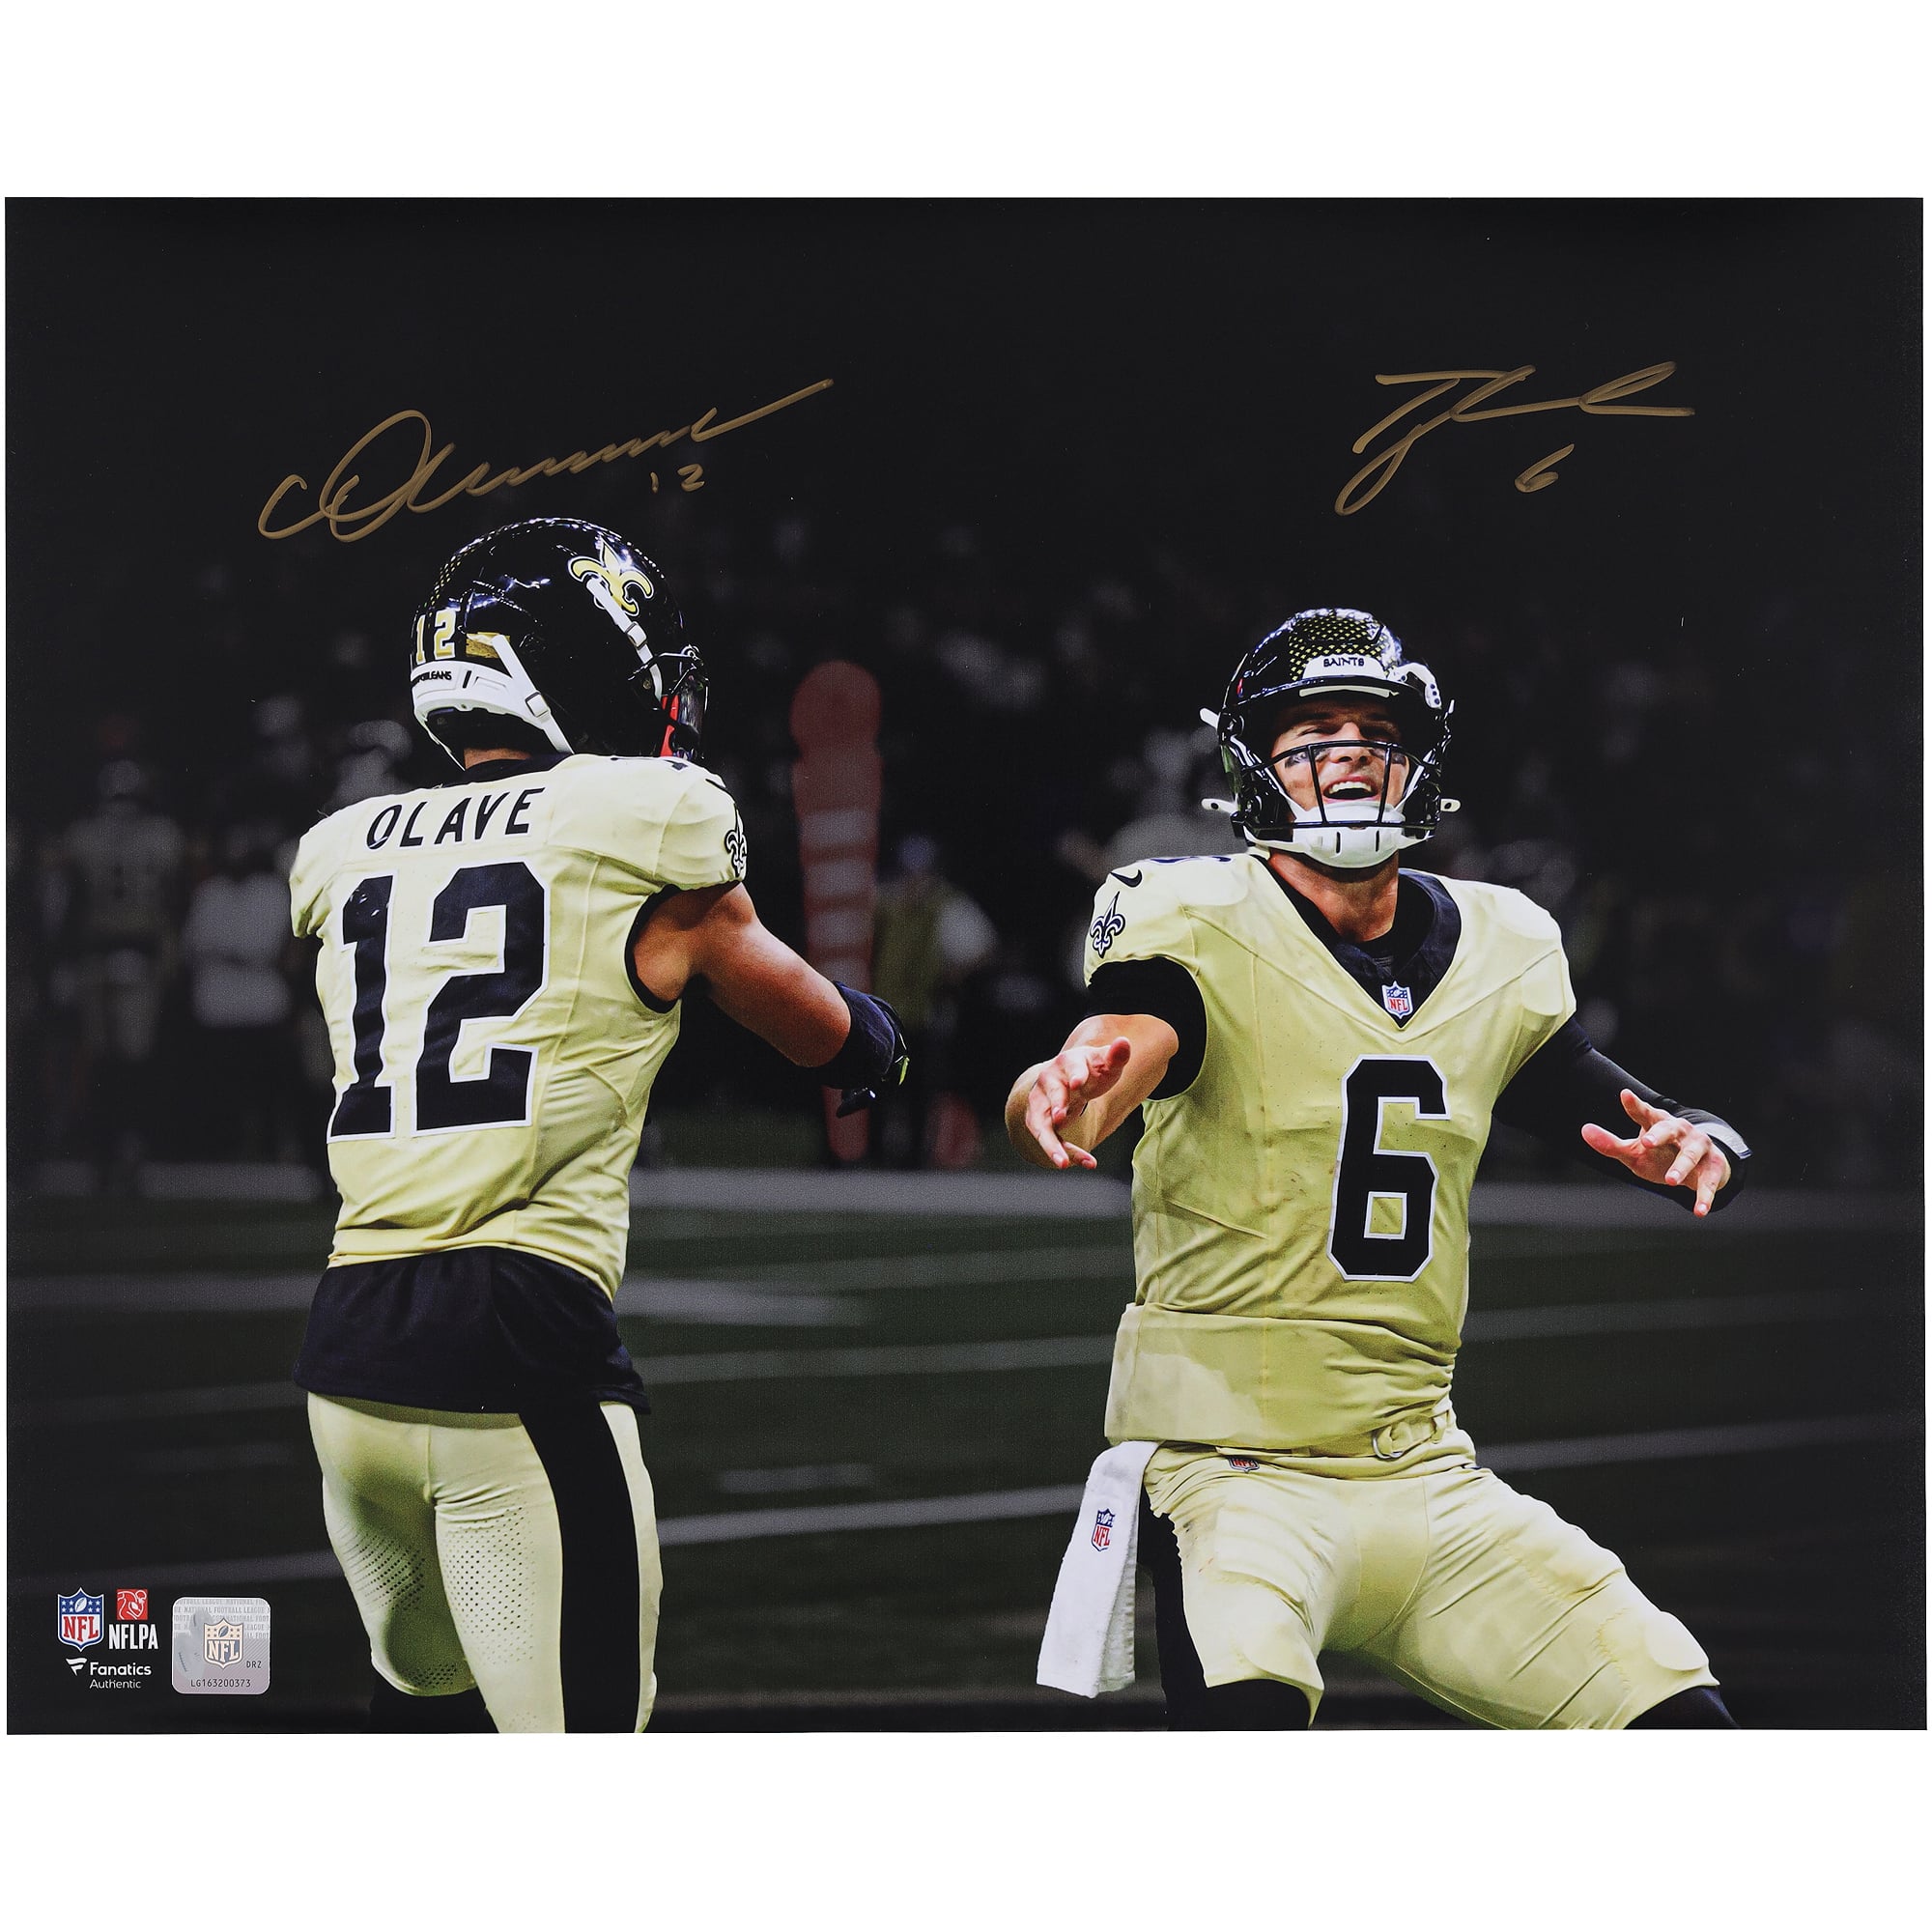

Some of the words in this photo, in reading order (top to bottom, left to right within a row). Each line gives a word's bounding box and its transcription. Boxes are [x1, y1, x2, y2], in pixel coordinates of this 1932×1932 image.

[415, 608, 458, 666] 12
[1323, 657, 1365, 667] SAINTS
[366, 787, 546, 850] OLAVE
[327, 860, 551, 1144] 12
[1389, 998, 1408, 1011] NFL
[1326, 1054, 1451, 1283] 6
[1093, 1525, 1111, 1548] NFL
[63, 1615, 99, 1642] NFL
[108, 1623, 159, 1650] NFLPA
[207, 1639, 240, 1662] NFL
[89, 1661, 153, 1676] Fanatics
[89, 1678, 142, 1690] Authentic
[190, 1679, 251, 1688] LG163200373
